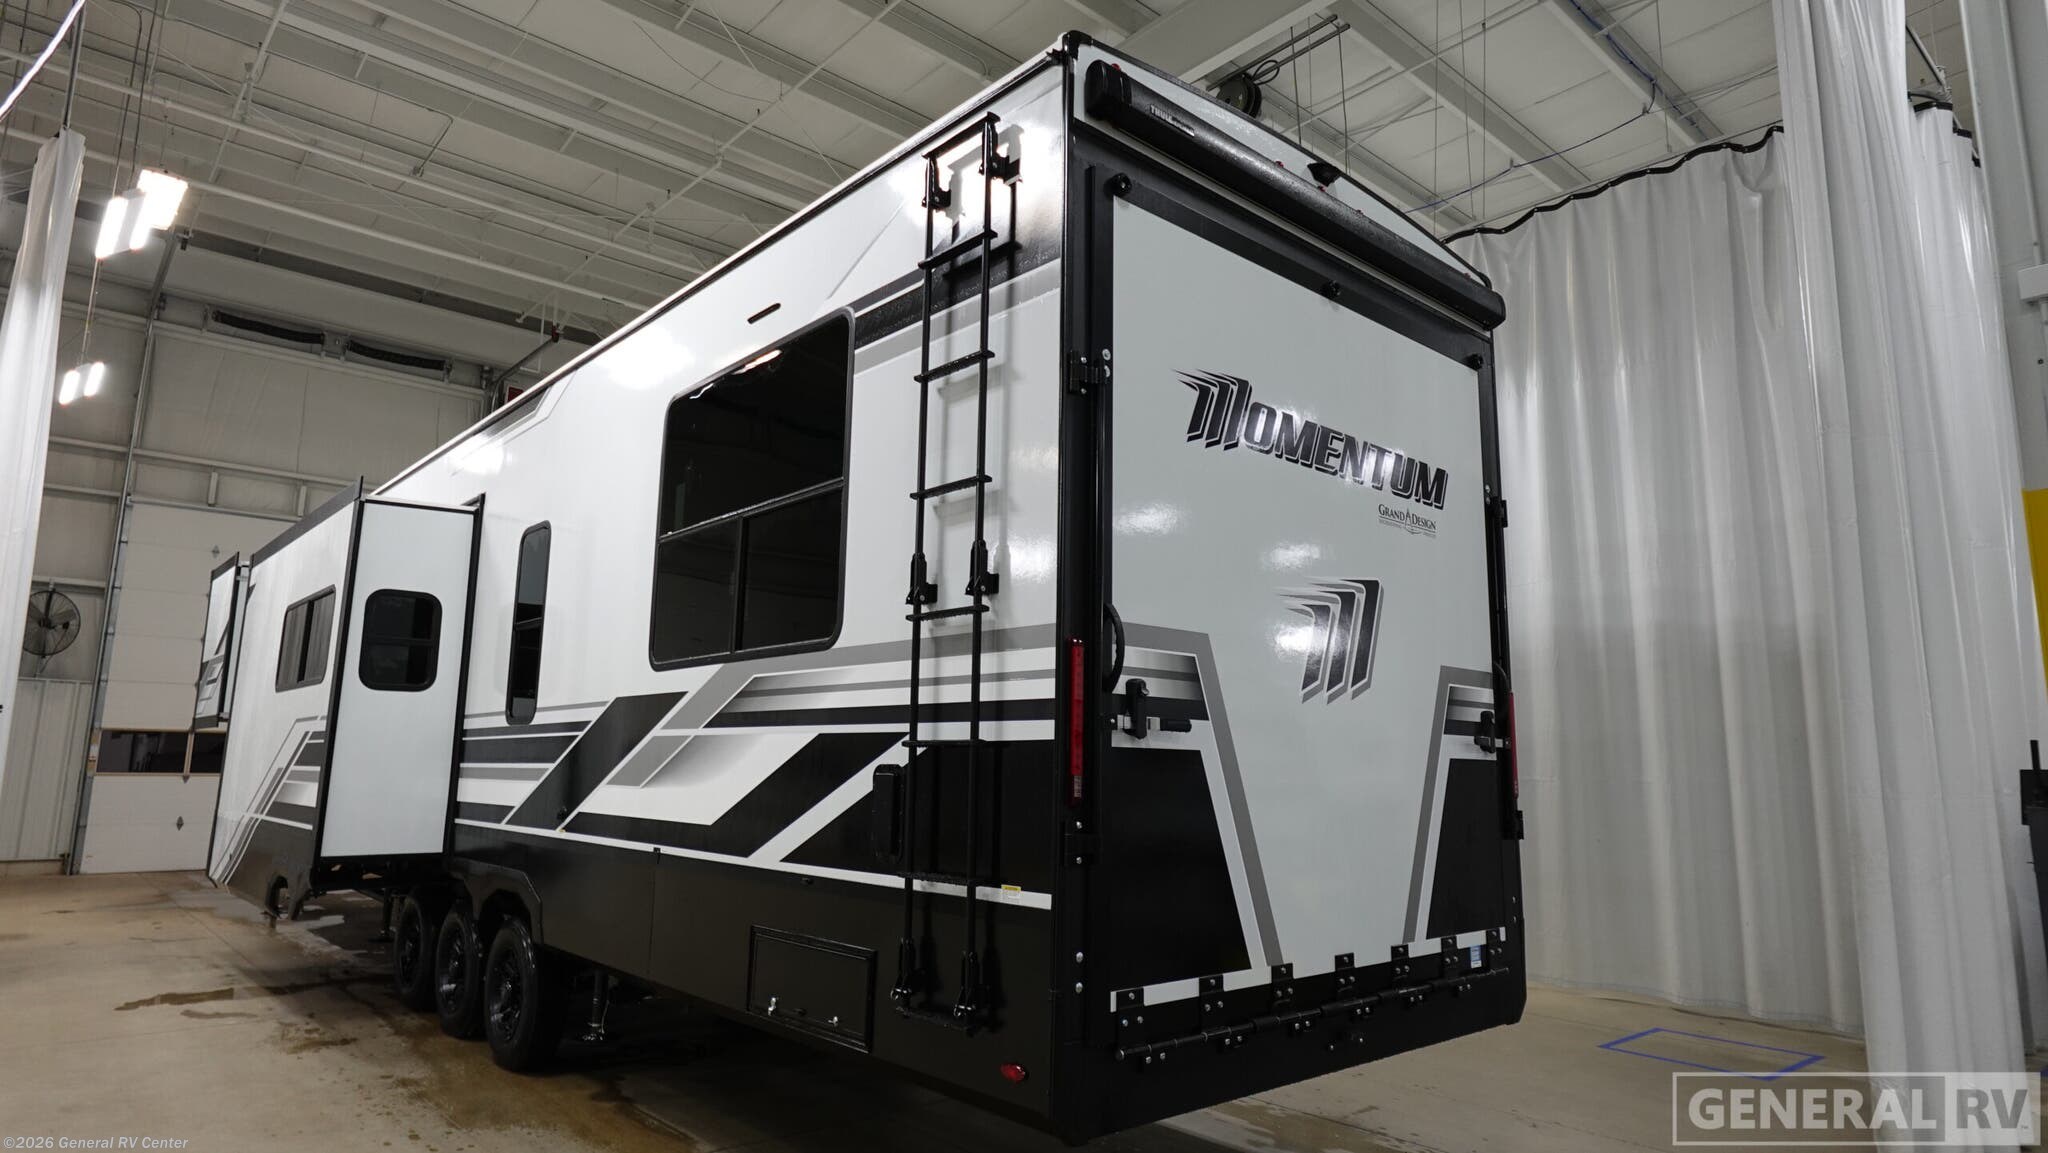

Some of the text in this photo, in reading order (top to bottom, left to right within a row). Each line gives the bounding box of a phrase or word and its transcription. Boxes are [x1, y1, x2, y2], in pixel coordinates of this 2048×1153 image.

[1172, 369, 1449, 510] MOMENTUM
[1378, 503, 1405, 521] GRAND
[1411, 512, 1437, 530] DESIGN
